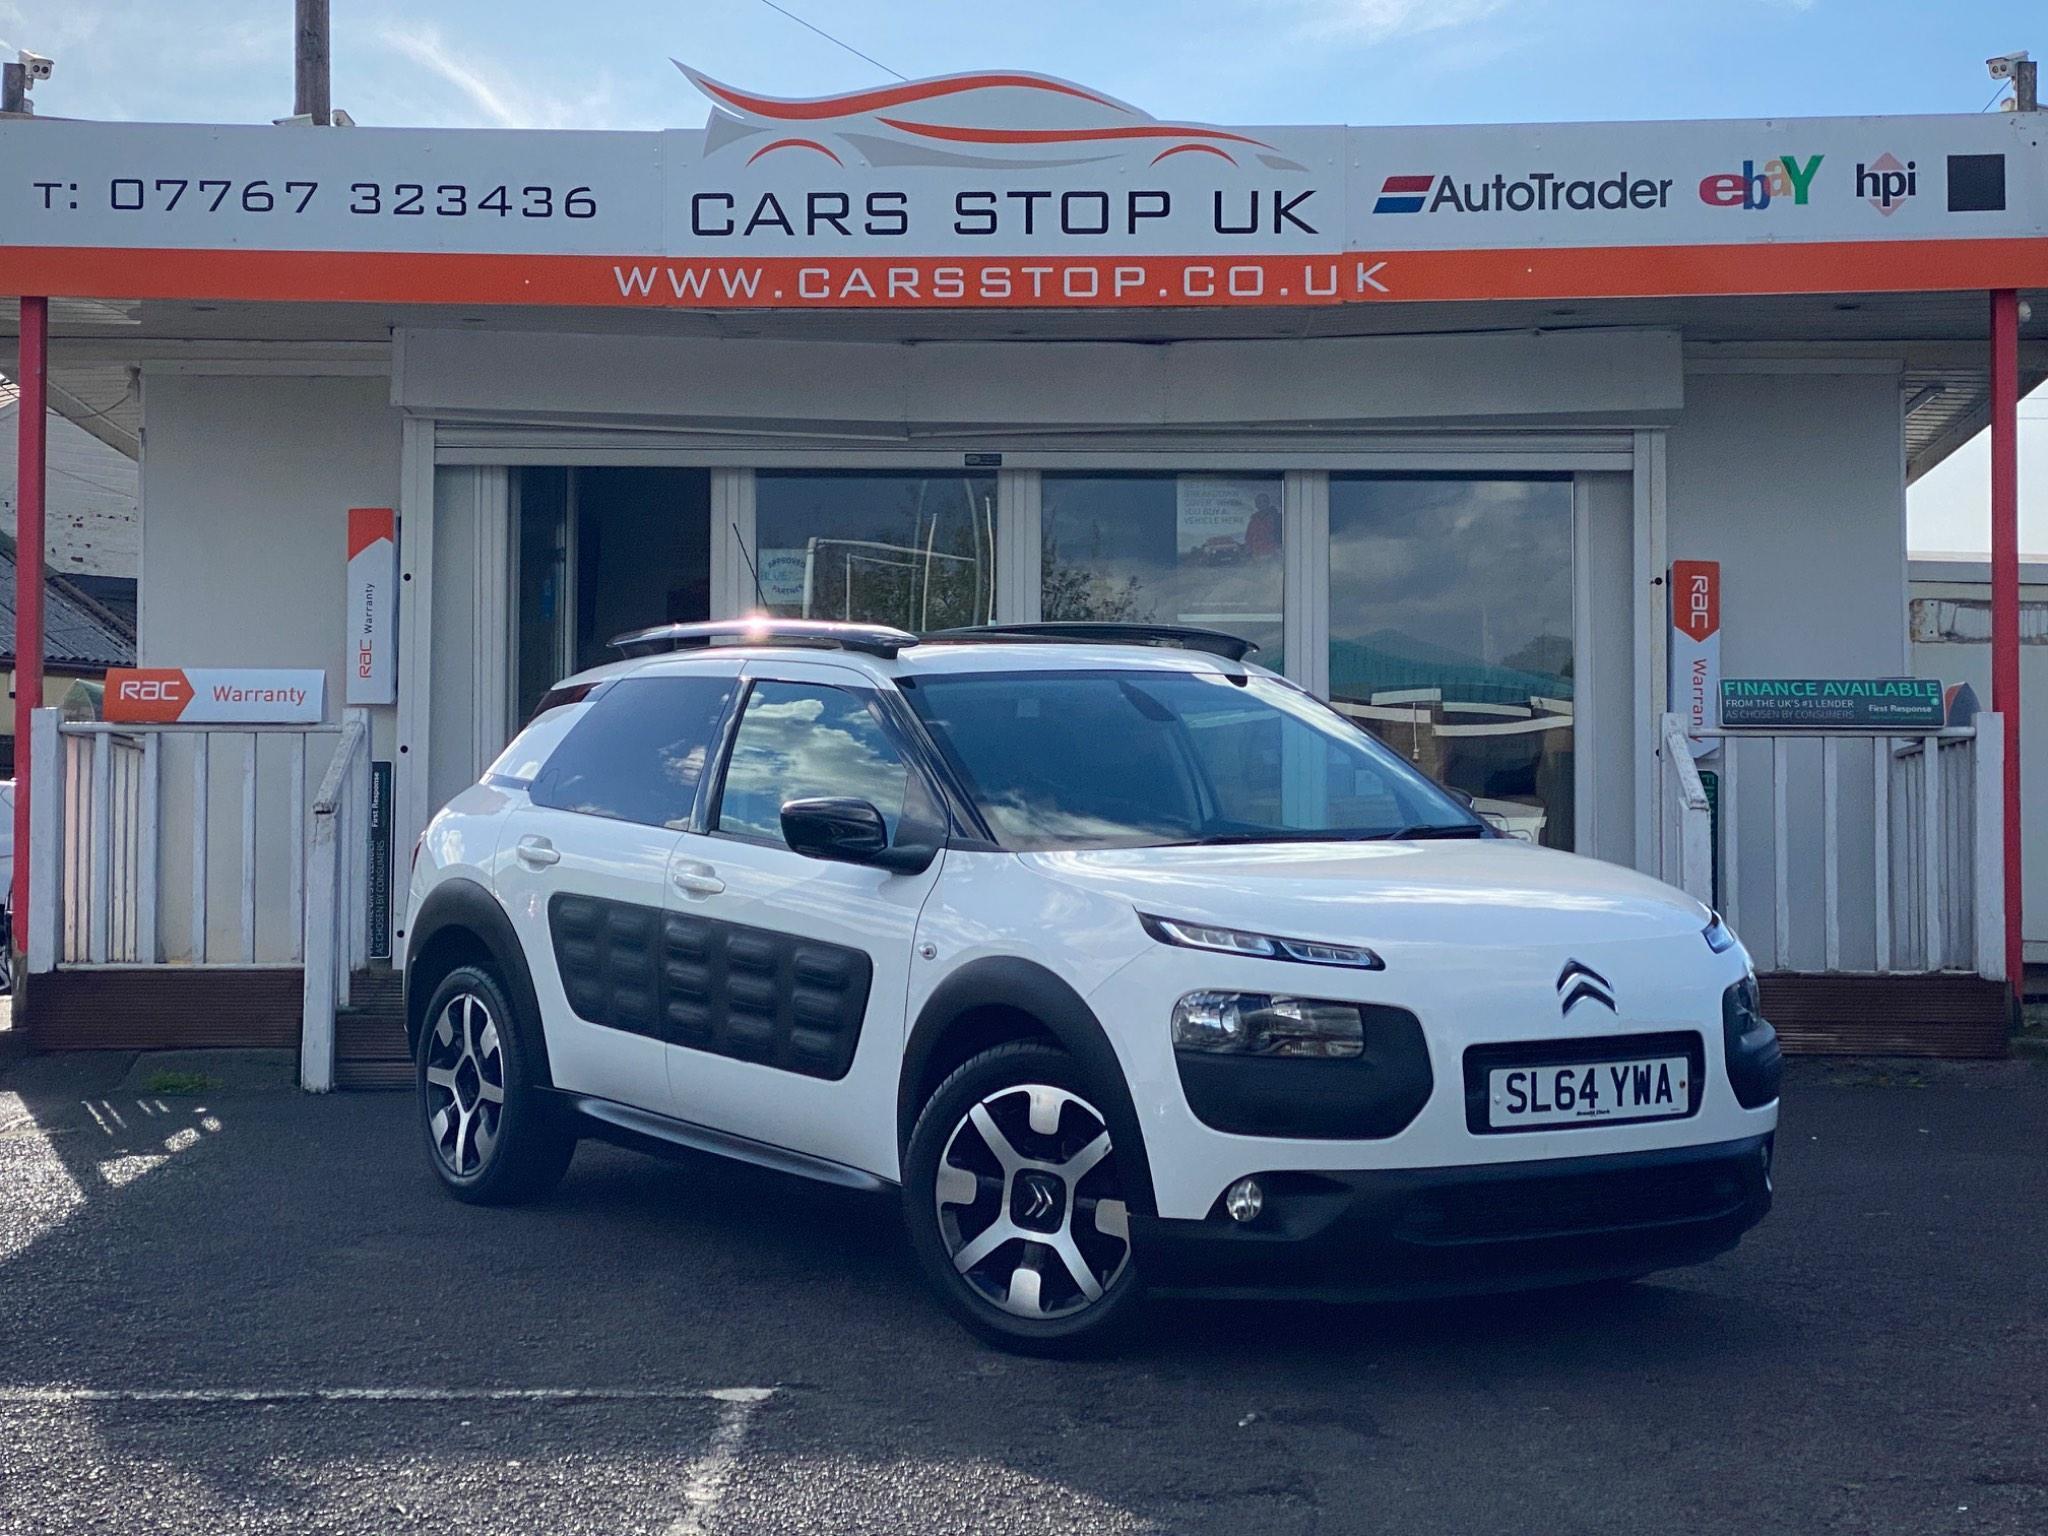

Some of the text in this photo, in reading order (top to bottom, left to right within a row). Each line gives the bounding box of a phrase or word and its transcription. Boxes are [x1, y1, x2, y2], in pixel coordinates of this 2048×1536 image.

[33, 178, 598, 219] T: 07767 323436
[1429, 171, 1673, 213] AutoTrader
[1856, 160, 1917, 207] hpi
[691, 190, 1319, 237] CARS STOP UK
[613, 261, 1390, 300] WWW.CARSSTOP.CO.UK
[363, 583, 376, 634] Warranty
[213, 685, 307, 706] Warranty
[1690, 658, 1708, 743] Warrany
[1723, 682, 1939, 697] FINANCE AVAILABLE
[1725, 699, 1753, 708] FROM
[1755, 699, 1775, 708] THE
[1777, 699, 1800, 708] UK'S
[1816, 699, 1854, 709] LENDER
[1889, 704, 1932, 714] Response
[1739, 710, 1780, 719] CHOSEN
[375, 839, 385, 893] CONSUMERS
[375, 905, 385, 942] CHOSEN
[1505, 1062, 1673, 1114] SL64 YWA
